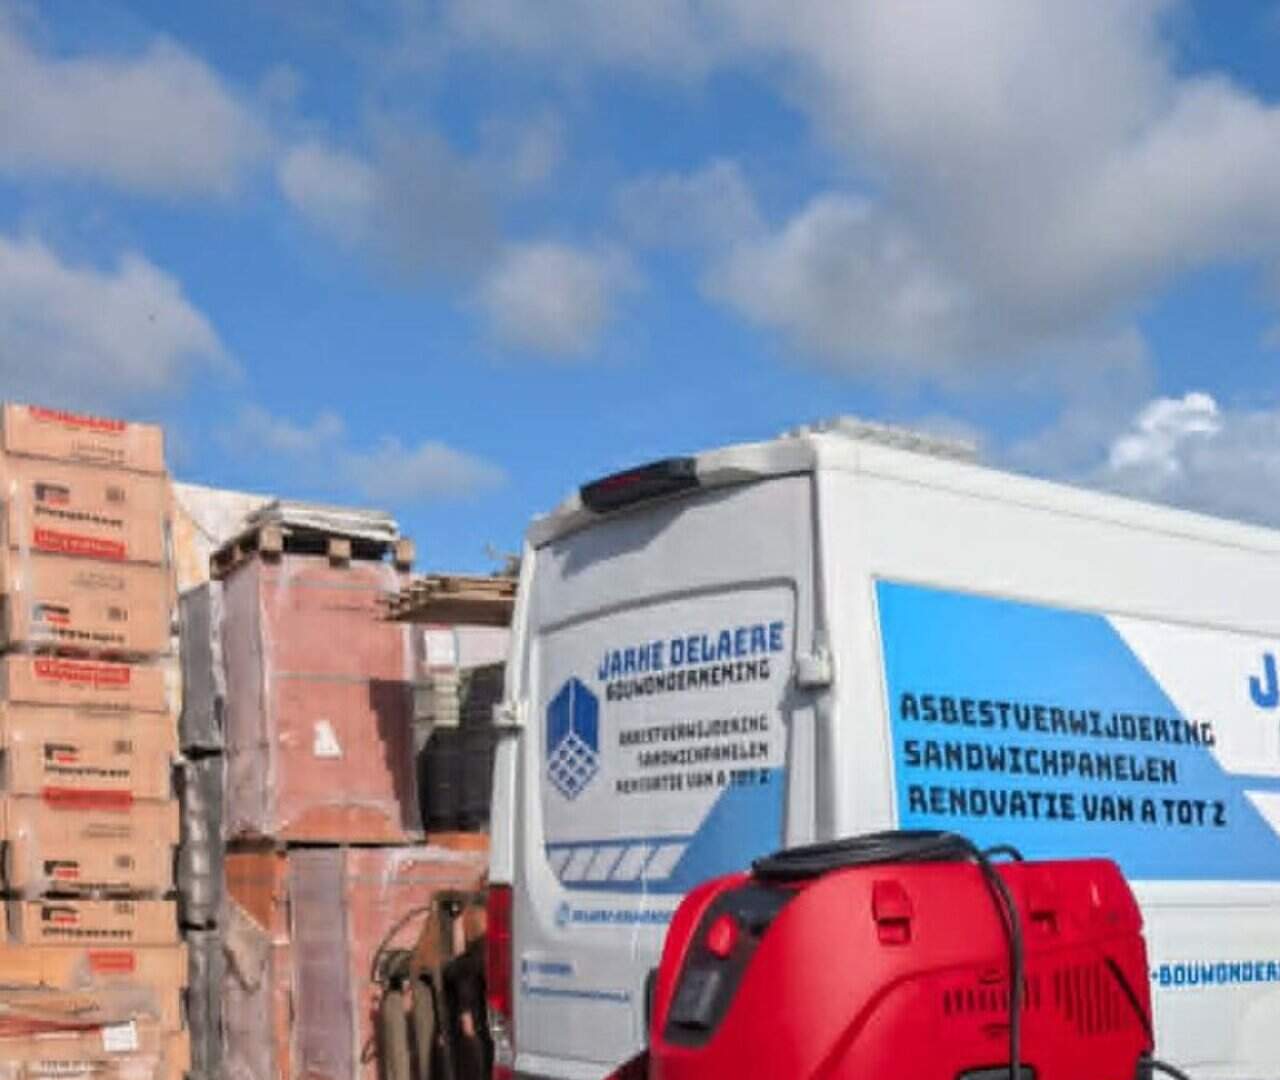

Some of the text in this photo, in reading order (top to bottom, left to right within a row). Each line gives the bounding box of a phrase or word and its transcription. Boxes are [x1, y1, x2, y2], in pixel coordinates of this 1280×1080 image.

[900, 693, 1217, 747] ASBESTVERWIJDERING
[904, 740, 1178, 784] SANDWICHPANELEN
[908, 785, 1076, 821] RENOVATIE
[1083, 793, 1134, 822] VAN
[1142, 800, 1156, 825] A
[1165, 800, 1209, 826] TOT
